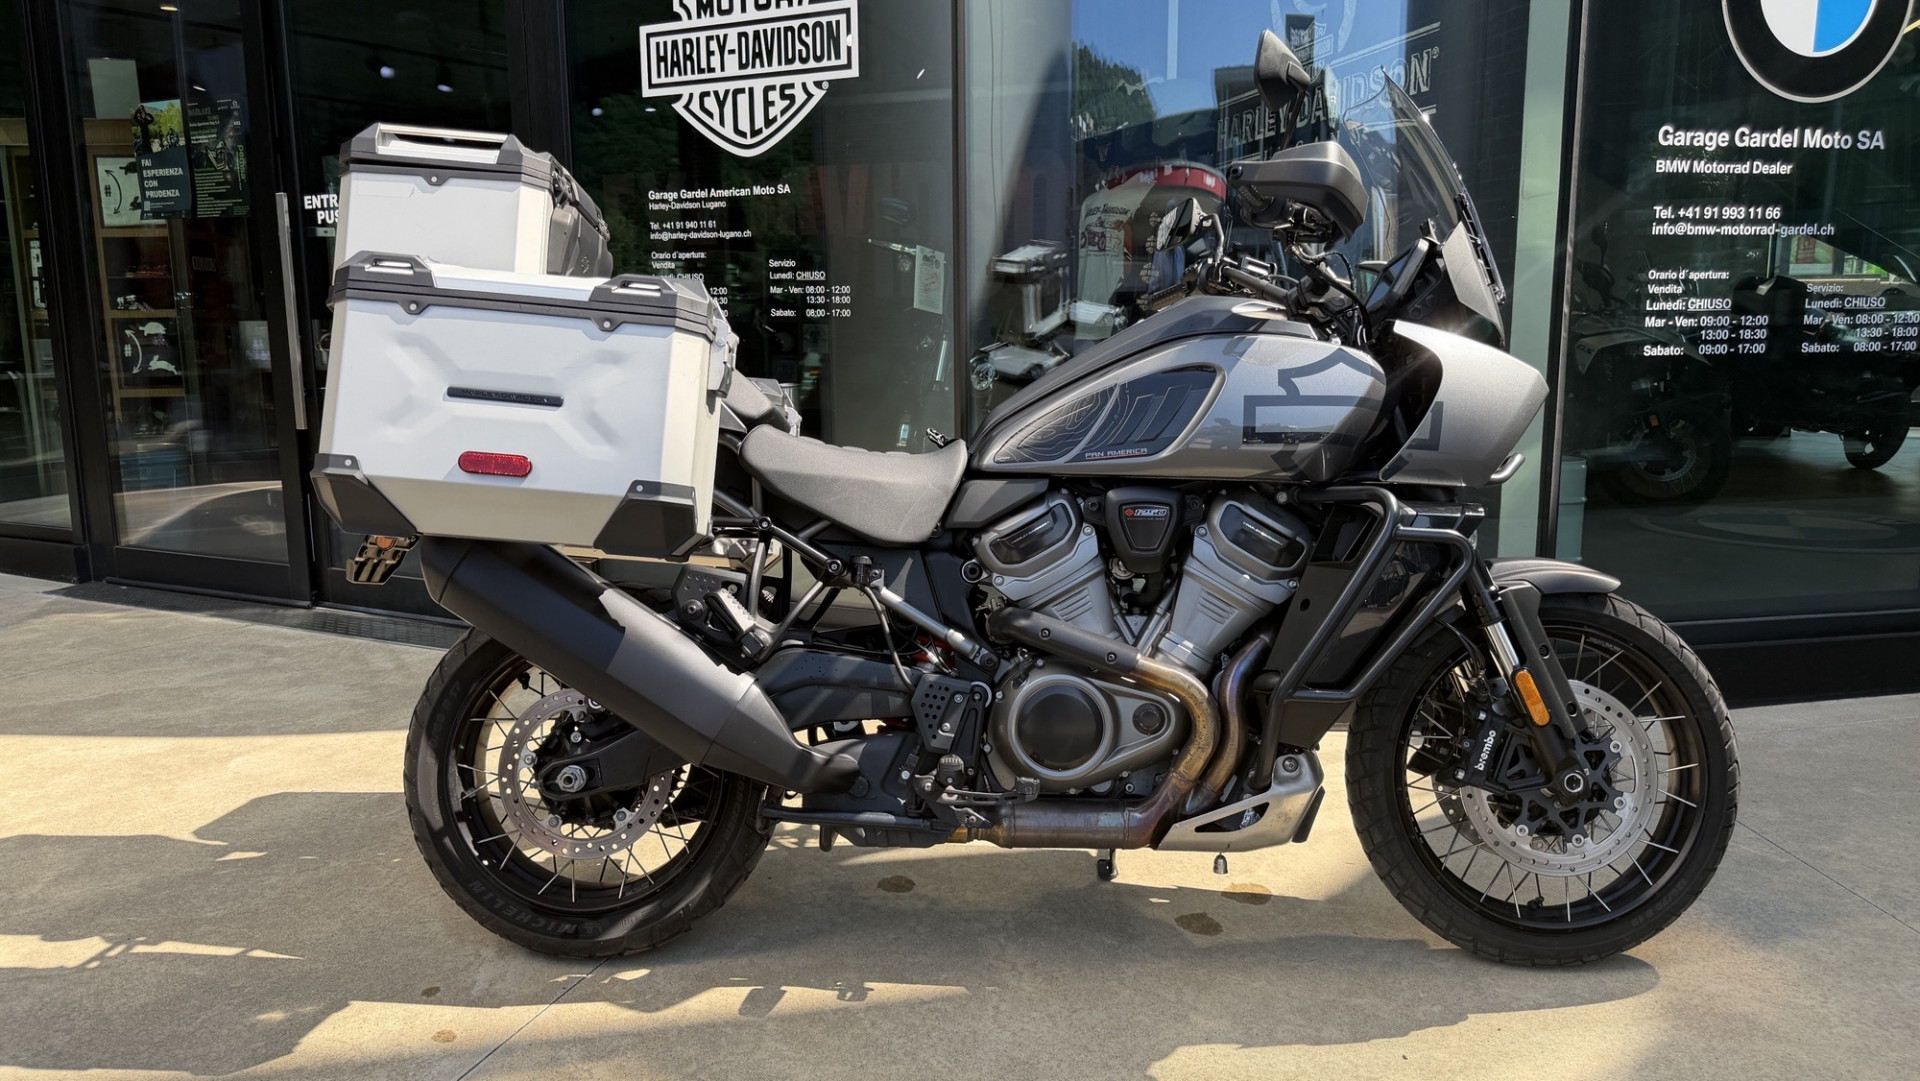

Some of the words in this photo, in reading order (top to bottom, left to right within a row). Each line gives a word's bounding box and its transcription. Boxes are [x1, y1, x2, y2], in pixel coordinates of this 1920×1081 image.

[655, 20, 841, 78] HARLEY-DAVIDSON
[698, 82, 796, 140] CYCLES
[1658, 124, 1730, 153] Garage
[1734, 126, 1800, 149] Gardel
[1803, 128, 1853, 150] Moto
[1856, 129, 1885, 150] SA
[141, 158, 152, 167] FAI
[1655, 158, 1692, 174] BMW
[1692, 158, 1751, 174] Motorrad
[1752, 160, 1793, 175] Dealer
[142, 167, 184, 178] ESPERIENZA
[143, 180, 159, 188] CON
[145, 189, 181, 199] PRUDENZA
[648, 189, 679, 202] Garage
[679, 188, 709, 199] Gardel
[709, 186, 751, 198] American
[752, 185, 776, 196] Moto
[777, 183, 791, 194] SA
[648, 200, 701, 211] Harley-Davidson
[701, 200, 727, 210] Lugano
[1653, 205, 1675, 219] Tel.
[1677, 206, 1701, 219] +41
[1703, 206, 1719, 220] 91
[1721, 206, 1746, 220] 993
[1748, 206, 1762, 220] 11
[1765, 206, 1781, 220] 66
[649, 221, 661, 231] Tel.
[662, 221, 675, 230] +41
[675, 221, 684, 230] 91
[684, 220, 699, 230] 940
[699, 220, 707, 229] 11
[707, 219, 717, 229] 61
[1651, 223, 1835, 237] info@bmw-motorrad-gardel.ch
[649, 229, 752, 241] info@harley-davidson-lugano.ch
[650, 251, 672, 260] Orario
[651, 260, 676, 270] Vendita
[768, 258, 797, 268] Servizio
[769, 271, 795, 280] Lunedì:
[795, 270, 826, 281] CHIUSO
[1648, 269, 1678, 280] Orario
[709, 287, 728, 295] 12:00
[769, 285, 784, 294] Mar
[788, 285, 805, 294] Ven:
[805, 285, 826, 294] 08:00
[831, 285, 851, 294] 12:00
[1647, 284, 1683, 294] Vendita
[1806, 282, 1844, 293] Servizio:
[806, 295, 826, 304] 13:30
[831, 295, 851, 304] 18:00
[1646, 298, 1686, 311] Lunedì:
[1687, 297, 1732, 312] CHIUSO
[1804, 297, 1843, 311] Lunedì:
[1844, 295, 1886, 310] CHIUSO
[770, 308, 797, 317] Sabato:
[805, 308, 826, 318] 08:00
[831, 308, 852, 318] 17:00
[1644, 316, 1667, 328] Mar
[1674, 315, 1698, 327] Ven:
[1699, 315, 1730, 327] 09:00
[1739, 314, 1769, 326] 12:00
[1803, 314, 1825, 327] Mar
[1830, 313, 1854, 326] Ven:
[1855, 313, 1884, 324] 08:00
[1892, 312, 1920, 323] 12:00
[1700, 329, 1729, 341] 13:00
[1738, 328, 1767, 340] 18:30
[1855, 327, 1883, 338] 13:30
[1891, 326, 1919, 339] 18:00
[1643, 344, 1684, 357] Sabato:
[1698, 343, 1728, 355] 09:00
[1737, 342, 1766, 354] 17:00
[1800, 342, 1840, 353] Sabato:
[1853, 341, 1882, 352] 08:00
[1890, 340, 1917, 351] 17:00
[1085, 451, 1104, 459] PAN
[1107, 447, 1148, 456] AMERICA
[1474, 729, 1497, 772] brembo
[468, 879, 578, 936] MICHELIN
